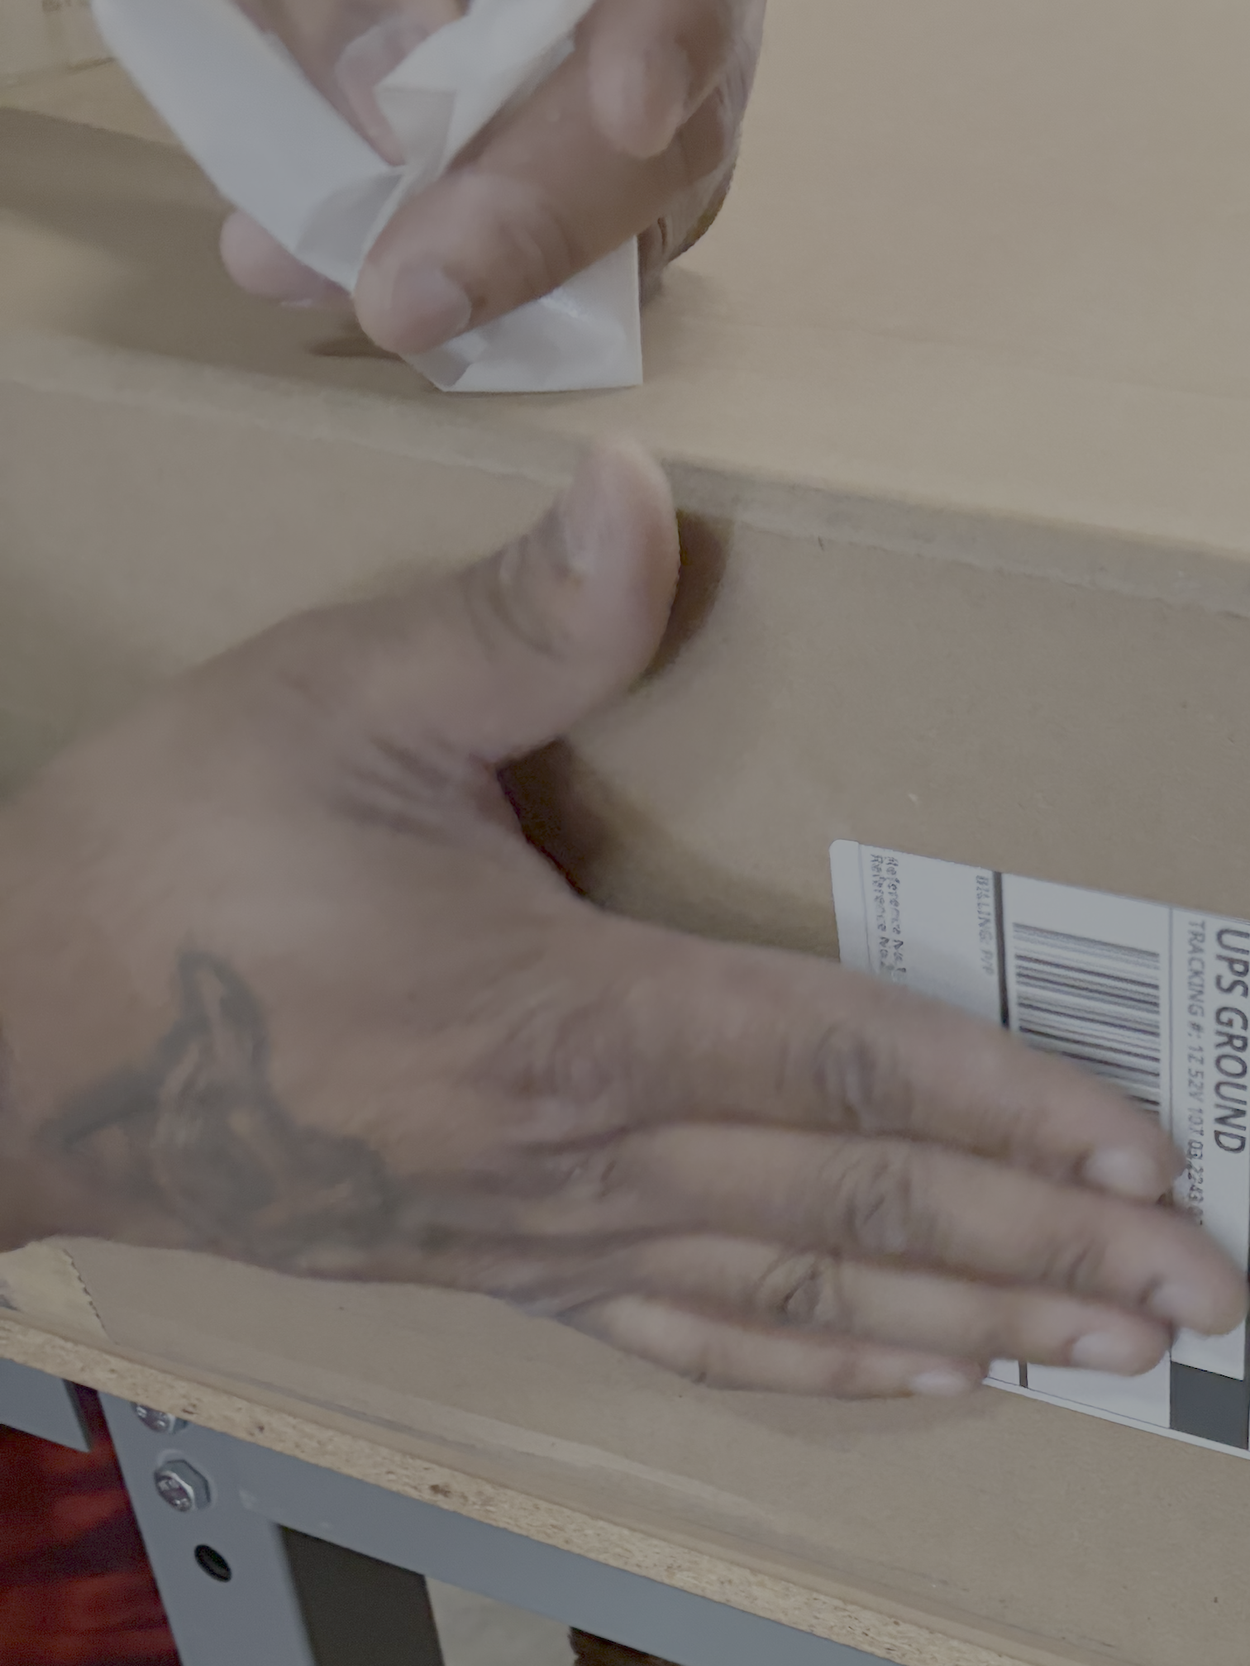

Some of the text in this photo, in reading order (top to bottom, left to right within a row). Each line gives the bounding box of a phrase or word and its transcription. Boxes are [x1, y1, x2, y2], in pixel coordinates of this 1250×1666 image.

[1187, 921, 1206, 1017] TRACKING
[1187, 1046, 1204, 1065] 1Z
[1188, 1021, 1204, 1038] #:
[1214, 928, 1250, 1153] UPS GROUND
